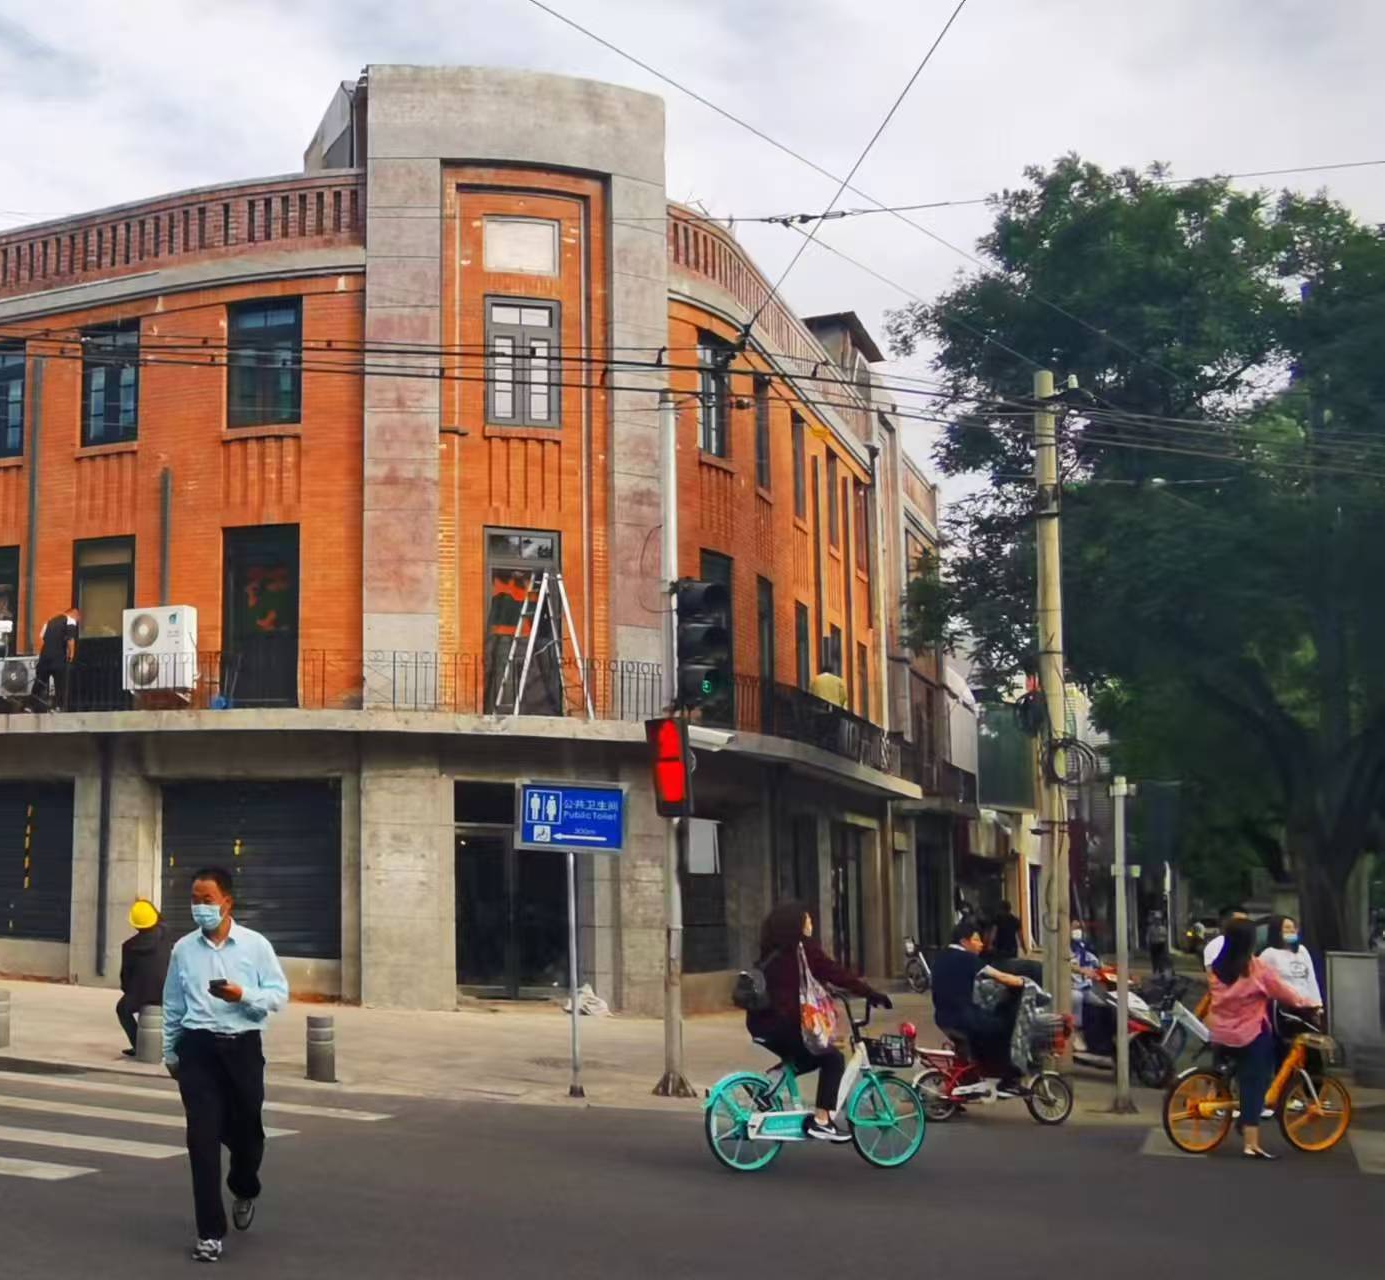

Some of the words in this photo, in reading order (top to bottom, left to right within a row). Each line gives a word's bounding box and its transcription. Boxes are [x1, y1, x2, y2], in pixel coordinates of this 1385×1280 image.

[563, 799, 619, 812] 公共卫生间
[563, 810, 592, 820] Public
[592, 811, 618, 822] Toilet
